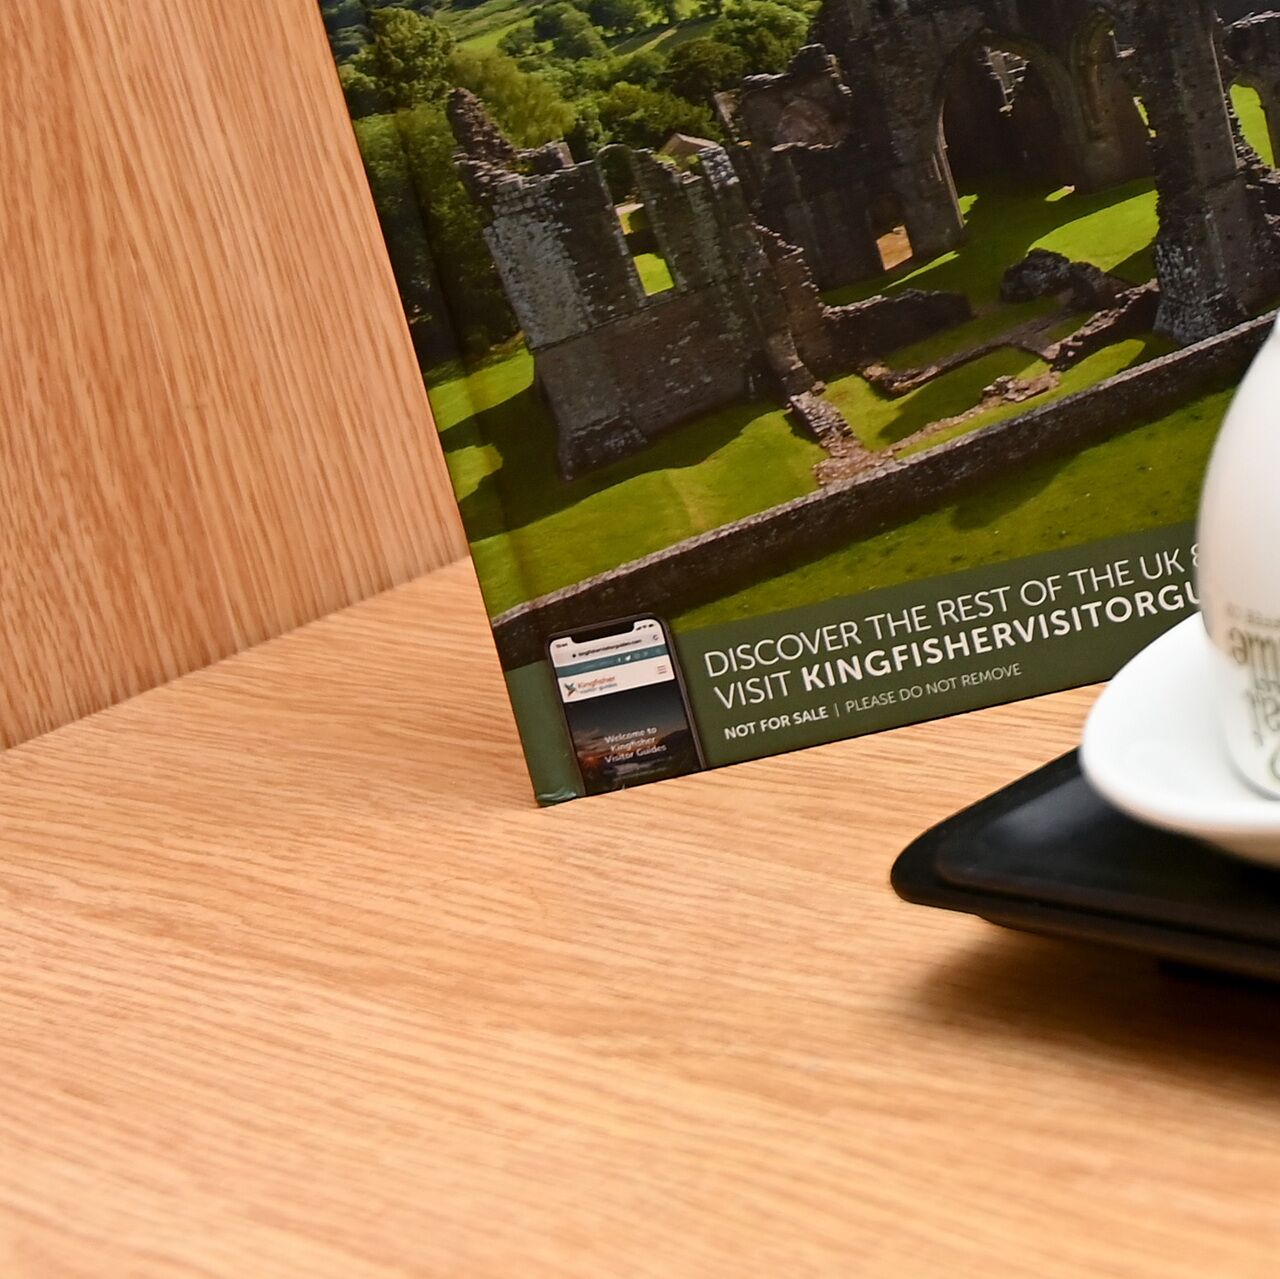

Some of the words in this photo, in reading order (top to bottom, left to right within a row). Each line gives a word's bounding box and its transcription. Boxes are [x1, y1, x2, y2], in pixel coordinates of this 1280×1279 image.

[704, 622, 861, 678] DISCOVER
[865, 604, 931, 641] THE
[937, 585, 1011, 626] REST
[1020, 574, 1063, 607] OF
[1068, 559, 1134, 596] THE
[1139, 548, 1185, 580] UK
[713, 670, 791, 710] VISIT
[724, 722, 756, 740] NOT
[760, 715, 791, 733] FOR
[793, 706, 829, 725] SALE
[845, 691, 896, 714] PLEASE
[900, 685, 923, 702] DO
[925, 677, 957, 696] NOT
[961, 663, 1022, 687] REMOVE
[604, 729, 646, 744] Welcome
[647, 727, 657, 735] to
[604, 752, 634, 763] Visitor
[636, 744, 667, 757] Guides
